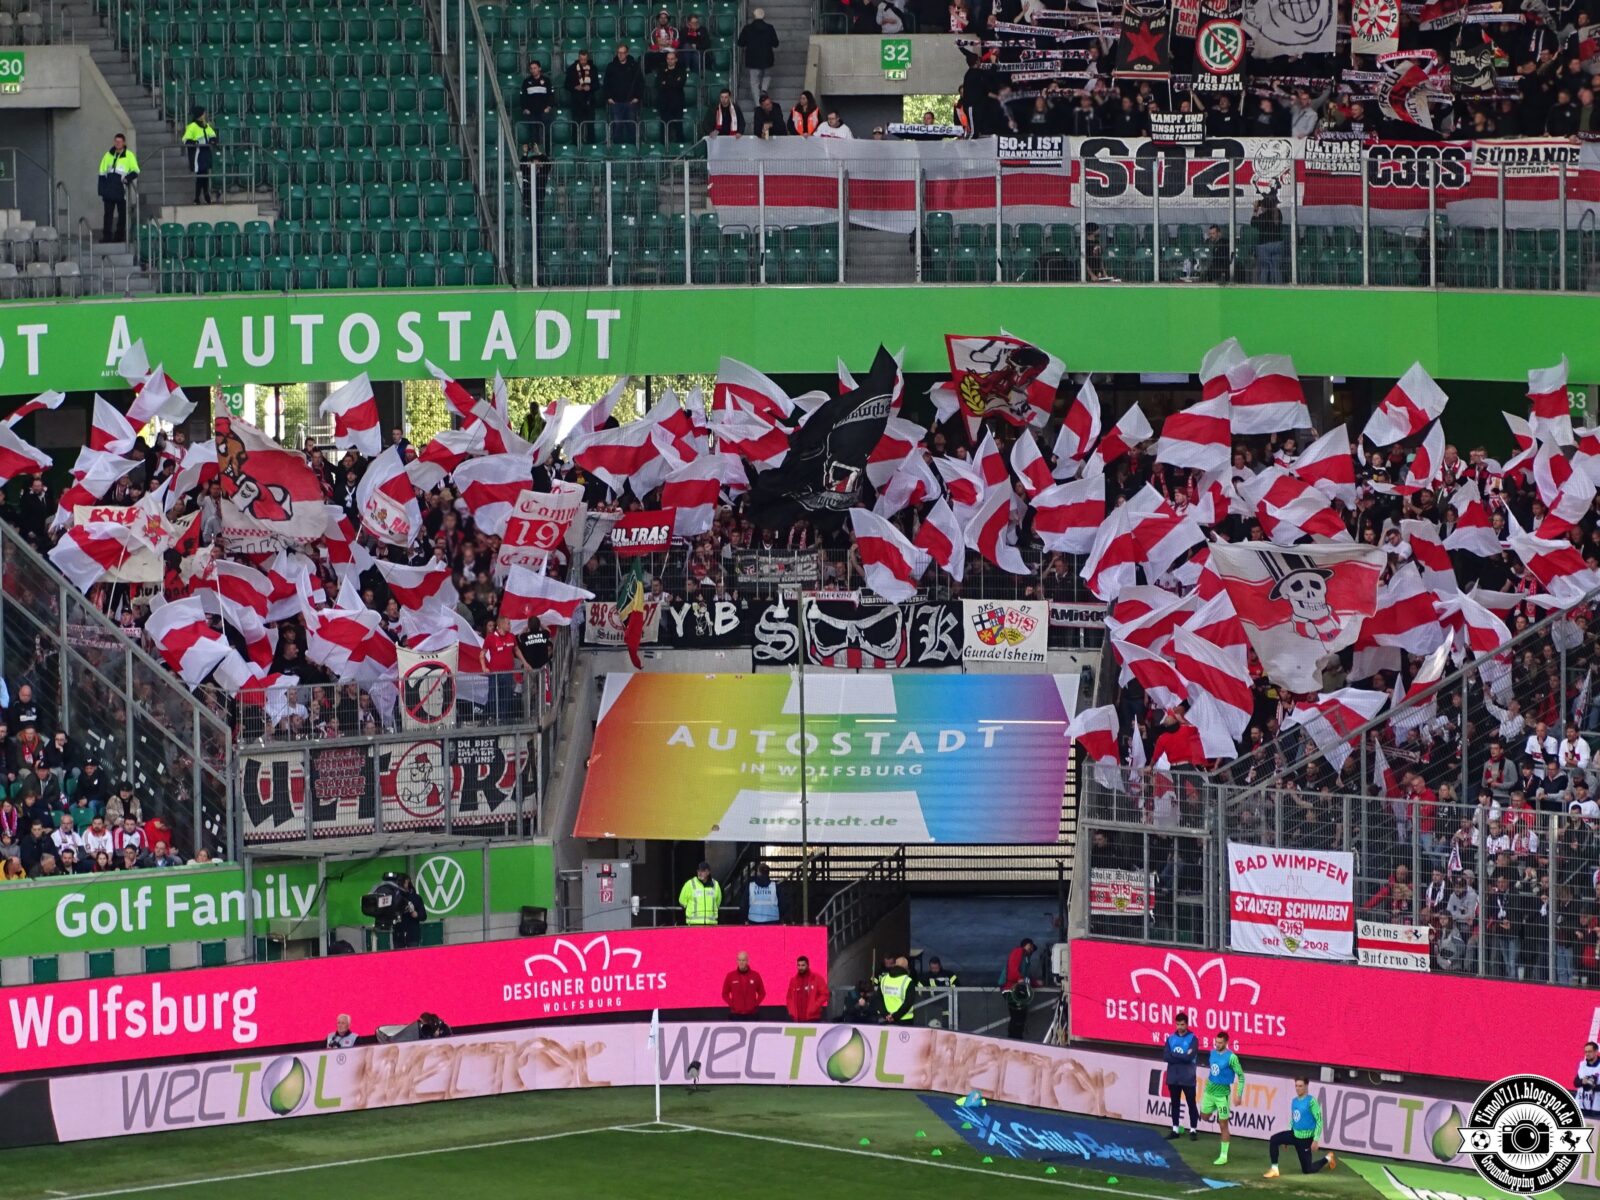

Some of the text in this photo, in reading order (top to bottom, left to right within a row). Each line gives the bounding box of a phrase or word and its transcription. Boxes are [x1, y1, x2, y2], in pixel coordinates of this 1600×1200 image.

[883, 44, 910, 61] 32
[0, 59, 22, 77] 30
[1192, 82, 1243, 91] FUSSBALL
[1197, 73, 1217, 83] FÜR
[1220, 74, 1240, 83] DEN
[1150, 113, 1204, 123] KAMPF UND
[1187, 122, 1203, 132] FÜR
[999, 136, 1062, 150] 50+1 IST
[1305, 139, 1360, 153] ULTRAS
[1476, 147, 1580, 165] SÜDBANDE
[1305, 161, 1360, 172] WIDERSTAND
[194, 309, 621, 369] AUTOSTADT
[1567, 391, 1586, 409] 33
[611, 526, 670, 543] ULTRAS
[964, 645, 1045, 662] Gundelsheim
[457, 739, 495, 749] DU BIST
[667, 724, 1004, 757] AUTOSTADT
[741, 762, 924, 778] IN WOLFSBURG
[749, 814, 898, 829] autostadt.de
[1234, 853, 1349, 885] BAD WIMPFEN
[56, 874, 317, 938] Golf Family
[1235, 895, 1349, 921] STAUFER SCHWABEN
[1361, 924, 1399, 940] Glems
[1262, 936, 1329, 951] seit 2008
[1362, 950, 1409, 967] Inferno
[503, 972, 667, 1002] DESIGNER OUTLETS
[543, 997, 622, 1013] WOLFSBURG
[10, 982, 258, 1050] Wolfsburg
[1106, 998, 1287, 1037] DESIGNR OUTLETS
